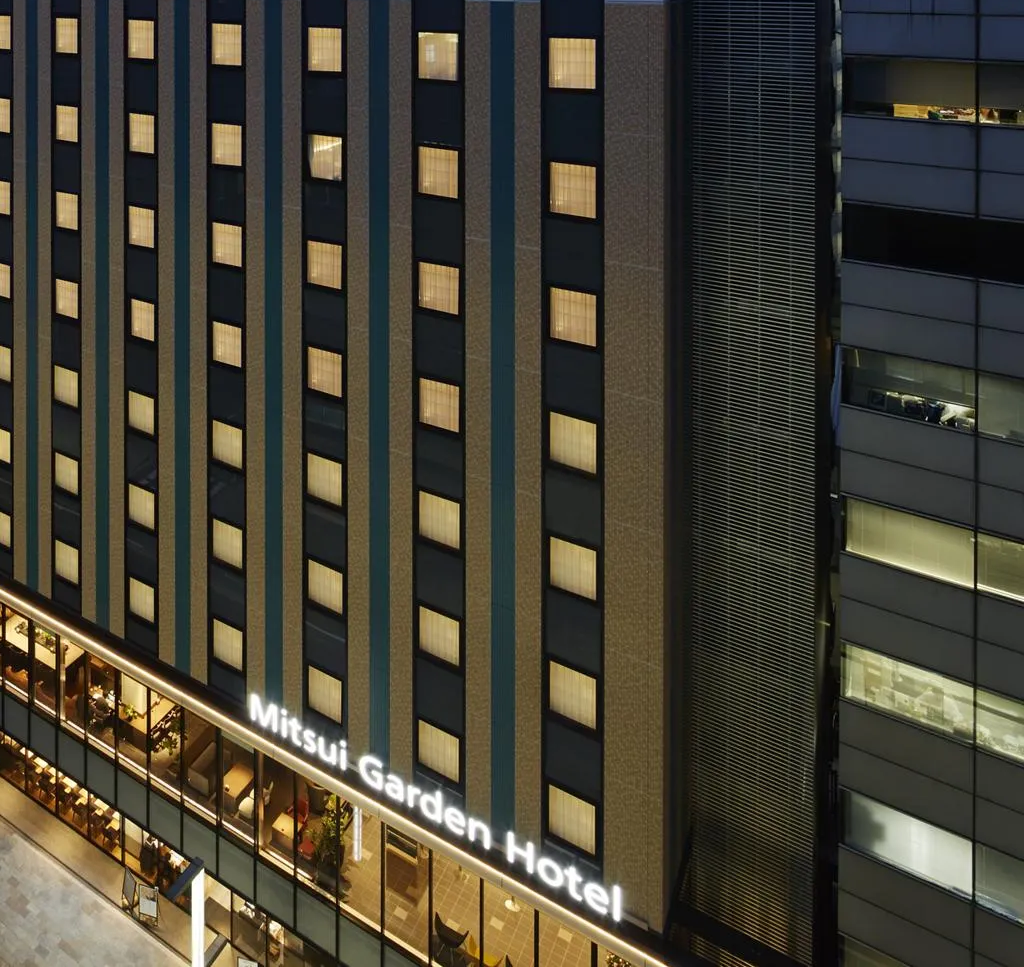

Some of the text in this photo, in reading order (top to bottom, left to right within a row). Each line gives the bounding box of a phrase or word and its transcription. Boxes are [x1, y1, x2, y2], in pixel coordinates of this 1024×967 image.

[249, 693, 622, 923] Mitsui Garden Hotel
